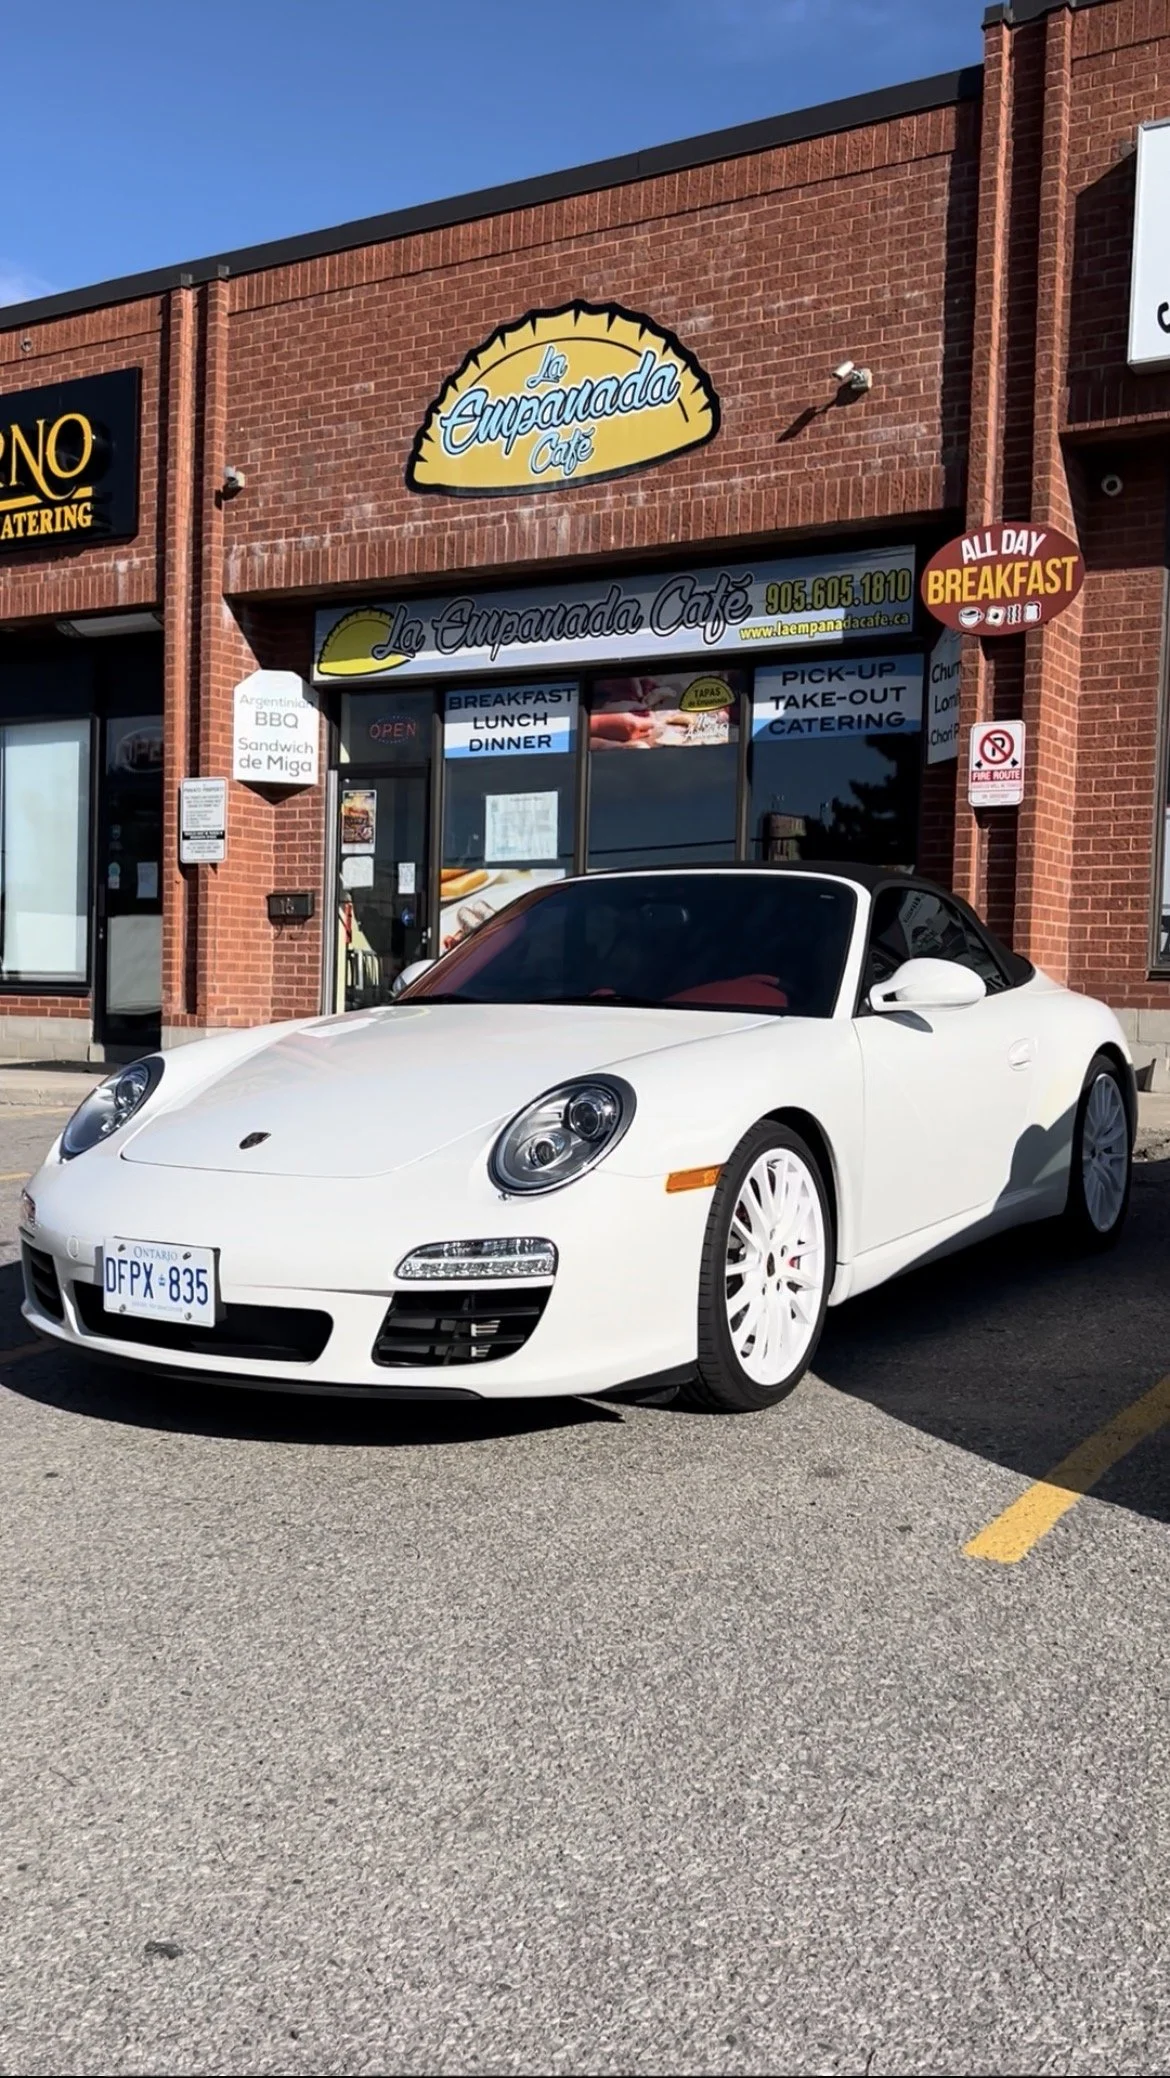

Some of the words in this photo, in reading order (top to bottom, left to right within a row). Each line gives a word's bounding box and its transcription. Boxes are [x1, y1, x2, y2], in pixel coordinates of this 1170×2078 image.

[527, 345, 567, 389] La
[439, 349, 680, 456] Empanada
[530, 426, 597, 476] Café
[0, 501, 93, 540] ATERING
[961, 531, 998, 565] ALL
[1001, 529, 1046, 558] DAY
[765, 568, 912, 615] 905.605.1810
[927, 556, 1079, 605] BREAKFAST
[372, 604, 426, 660] La
[432, 584, 644, 662] Empanada
[650, 571, 754, 645] Café
[739, 612, 911, 640] www.laempanadacafe.ca
[782, 662, 896, 686] PICK-UP
[448, 688, 577, 710] BREAKFAST
[694, 686, 721, 698] TAPAS
[770, 686, 906, 710] TAKE-OUT
[255, 711, 299, 729] BBQ
[370, 723, 416, 738] OPEN
[473, 712, 548, 730] LUNCH
[768, 711, 906, 735] CATERING
[238, 737, 314, 755] Sandwich
[469, 734, 552, 752] DINNER
[239, 754, 263, 770] de
[267, 755, 313, 777] Miga
[973, 771, 991, 781] FIRE
[993, 770, 1020, 780] ROUTE
[133, 1246, 178, 1261] ONTARIO
